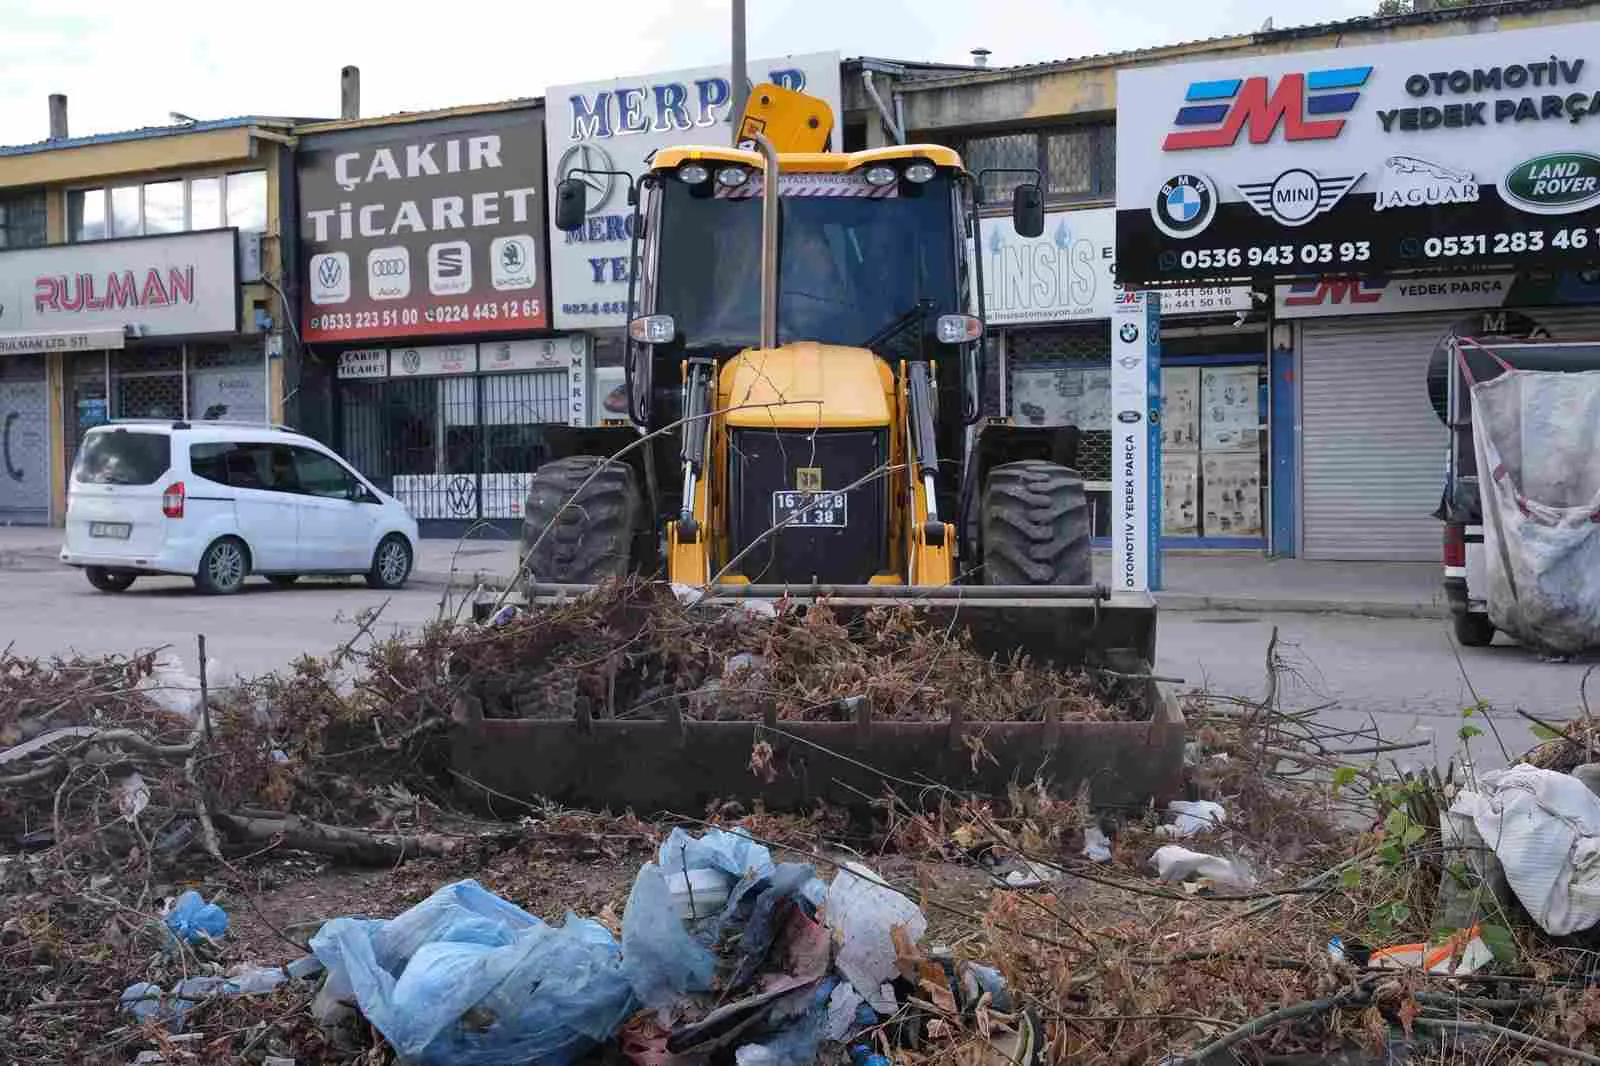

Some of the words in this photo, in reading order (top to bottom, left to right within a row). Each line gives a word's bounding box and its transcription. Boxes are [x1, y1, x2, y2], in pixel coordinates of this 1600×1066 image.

[1405, 55, 1585, 97] OTOMOTİV
[1376, 101, 1486, 133] YEDEK
[334, 135, 502, 191] ÇAKIR
[1528, 162, 1580, 181] LAND
[1276, 187, 1314, 203] MINI
[1374, 183, 1475, 209] JAGUAR
[1533, 176, 1597, 196] ROVER
[307, 188, 535, 242] TİCARET
[1180, 248, 1242, 269] 0536
[1248, 245, 1294, 265] 943
[1301, 243, 1332, 264] 03
[1339, 241, 1370, 262] 93
[1424, 235, 1486, 258] 0531
[1493, 231, 1544, 254] 283
[1552, 228, 1588, 249] 46
[34, 266, 195, 314] RULMAN
[1400, 283, 1447, 297] YEDEK
[1451, 279, 1504, 297] PARÇA
[321, 314, 352, 331] 0533
[355, 311, 379, 329] 223
[383, 309, 398, 327] 51
[402, 307, 418, 325] 00
[436, 304, 468, 322] 0224
[473, 303, 497, 320] 443
[502, 301, 519, 319] 12
[523, 299, 539, 317] 65
[1125, 434, 1137, 477] PARÇA
[778, 493, 795, 509] 16
[1125, 480, 1135, 520] YEDEK
